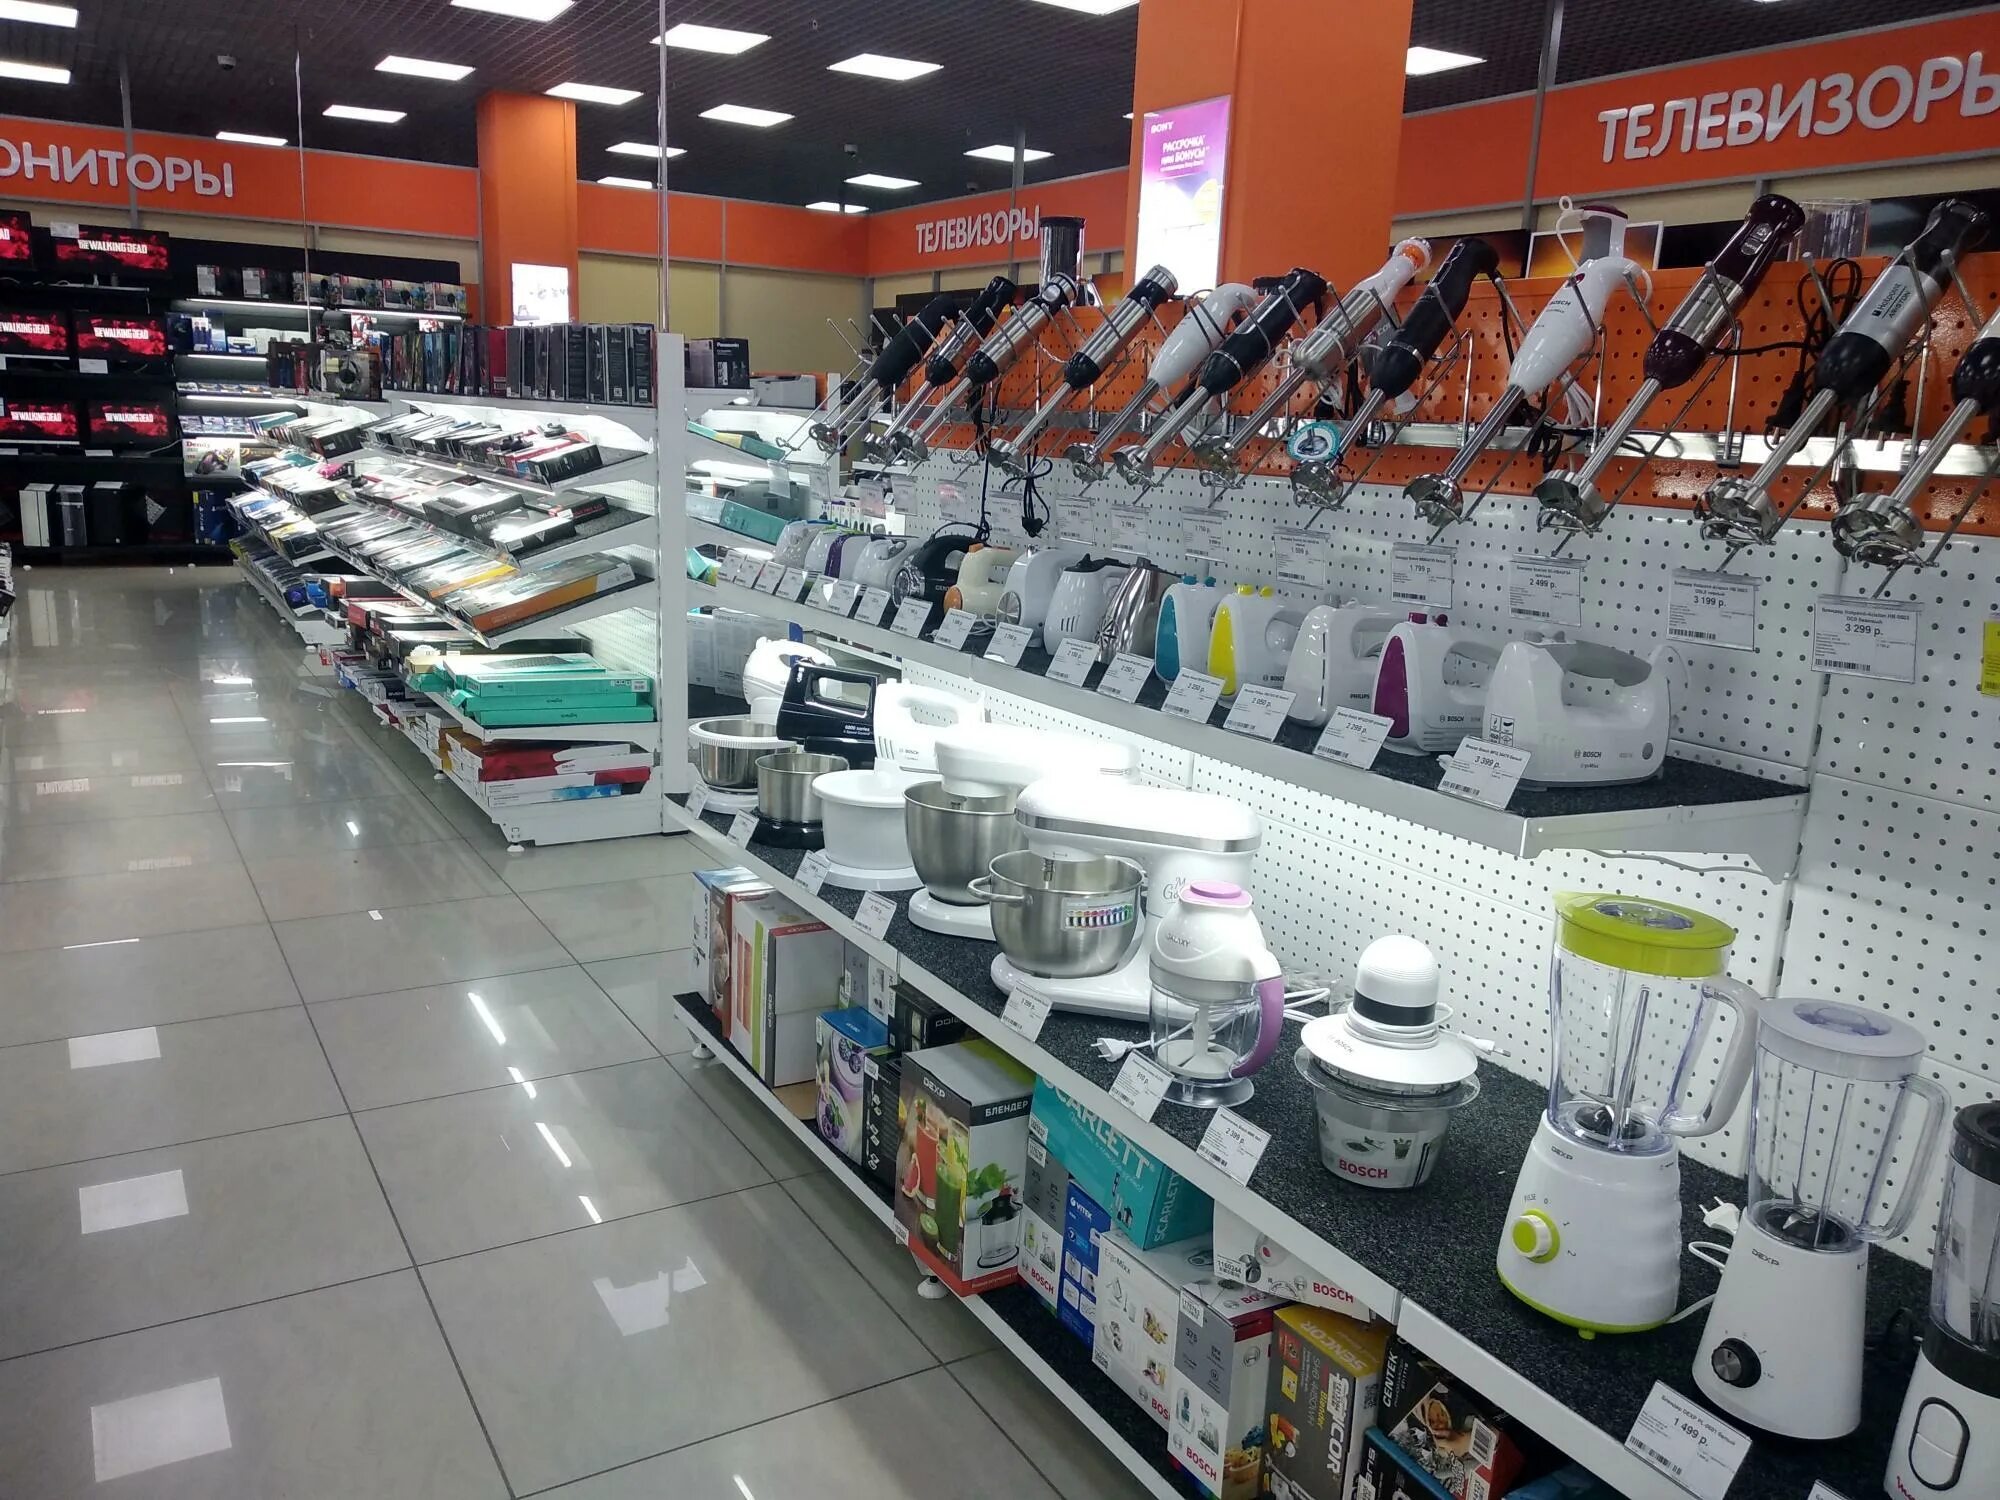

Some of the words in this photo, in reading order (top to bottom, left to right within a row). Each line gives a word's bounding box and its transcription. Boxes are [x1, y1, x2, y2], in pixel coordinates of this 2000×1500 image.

[0, 137, 234, 198] ОНИТОРЫ
[915, 204, 1040, 254] ТЕЛЕВИЗОРЫ
[88, 240, 126, 253] WALKING
[127, 243, 148, 254] DEAD
[2, 322, 32, 334] WALKING
[32, 324, 50, 334] DEAD
[102, 327, 131, 339] WALKING
[131, 328, 149, 340] DEAD
[19, 411, 46, 422] WALKING
[46, 412, 62, 422] DEAD
[113, 412, 138, 422] WALKING
[138, 413, 153, 423] DEAD
[1529, 578, 1535, 586] 2
[1535, 579, 1549, 587] 499
[1693, 595, 1699, 604] 3
[1701, 596, 1716, 606] 199
[1844, 623, 1852, 632] 3
[1853, 624, 1871, 634] 299
[1873, 627, 1884, 637] р.
[1474, 755, 1480, 763] 3
[1480, 757, 1494, 767] 399
[1582, 751, 1602, 759] BOSCH
[923, 1076, 946, 1099] DEXP
[985, 1099, 1029, 1118] БЛЕНДЕР
[1225, 1127, 1231, 1135] 2
[1551, 1145, 1574, 1160] DEXP
[1338, 1158, 1388, 1179] BOSCH
[1751, 1248, 1780, 1266] DEXP
[1031, 1268, 1054, 1295] BOSCH
[1241, 1290, 1267, 1305] BOS
[1312, 1282, 1355, 1304] BOSCH
[1301, 1320, 1369, 1371] SENCOR
[1382, 1351, 1399, 1408] CENTEK
[1151, 1397, 1171, 1421] BOS
[1673, 1417, 1680, 1427] 1
[1680, 1422, 1699, 1440] 499
[1698, 1436, 1709, 1448] р.
[1186, 1447, 1218, 1482] BOSCH
[1365, 1447, 1376, 1484] aris
